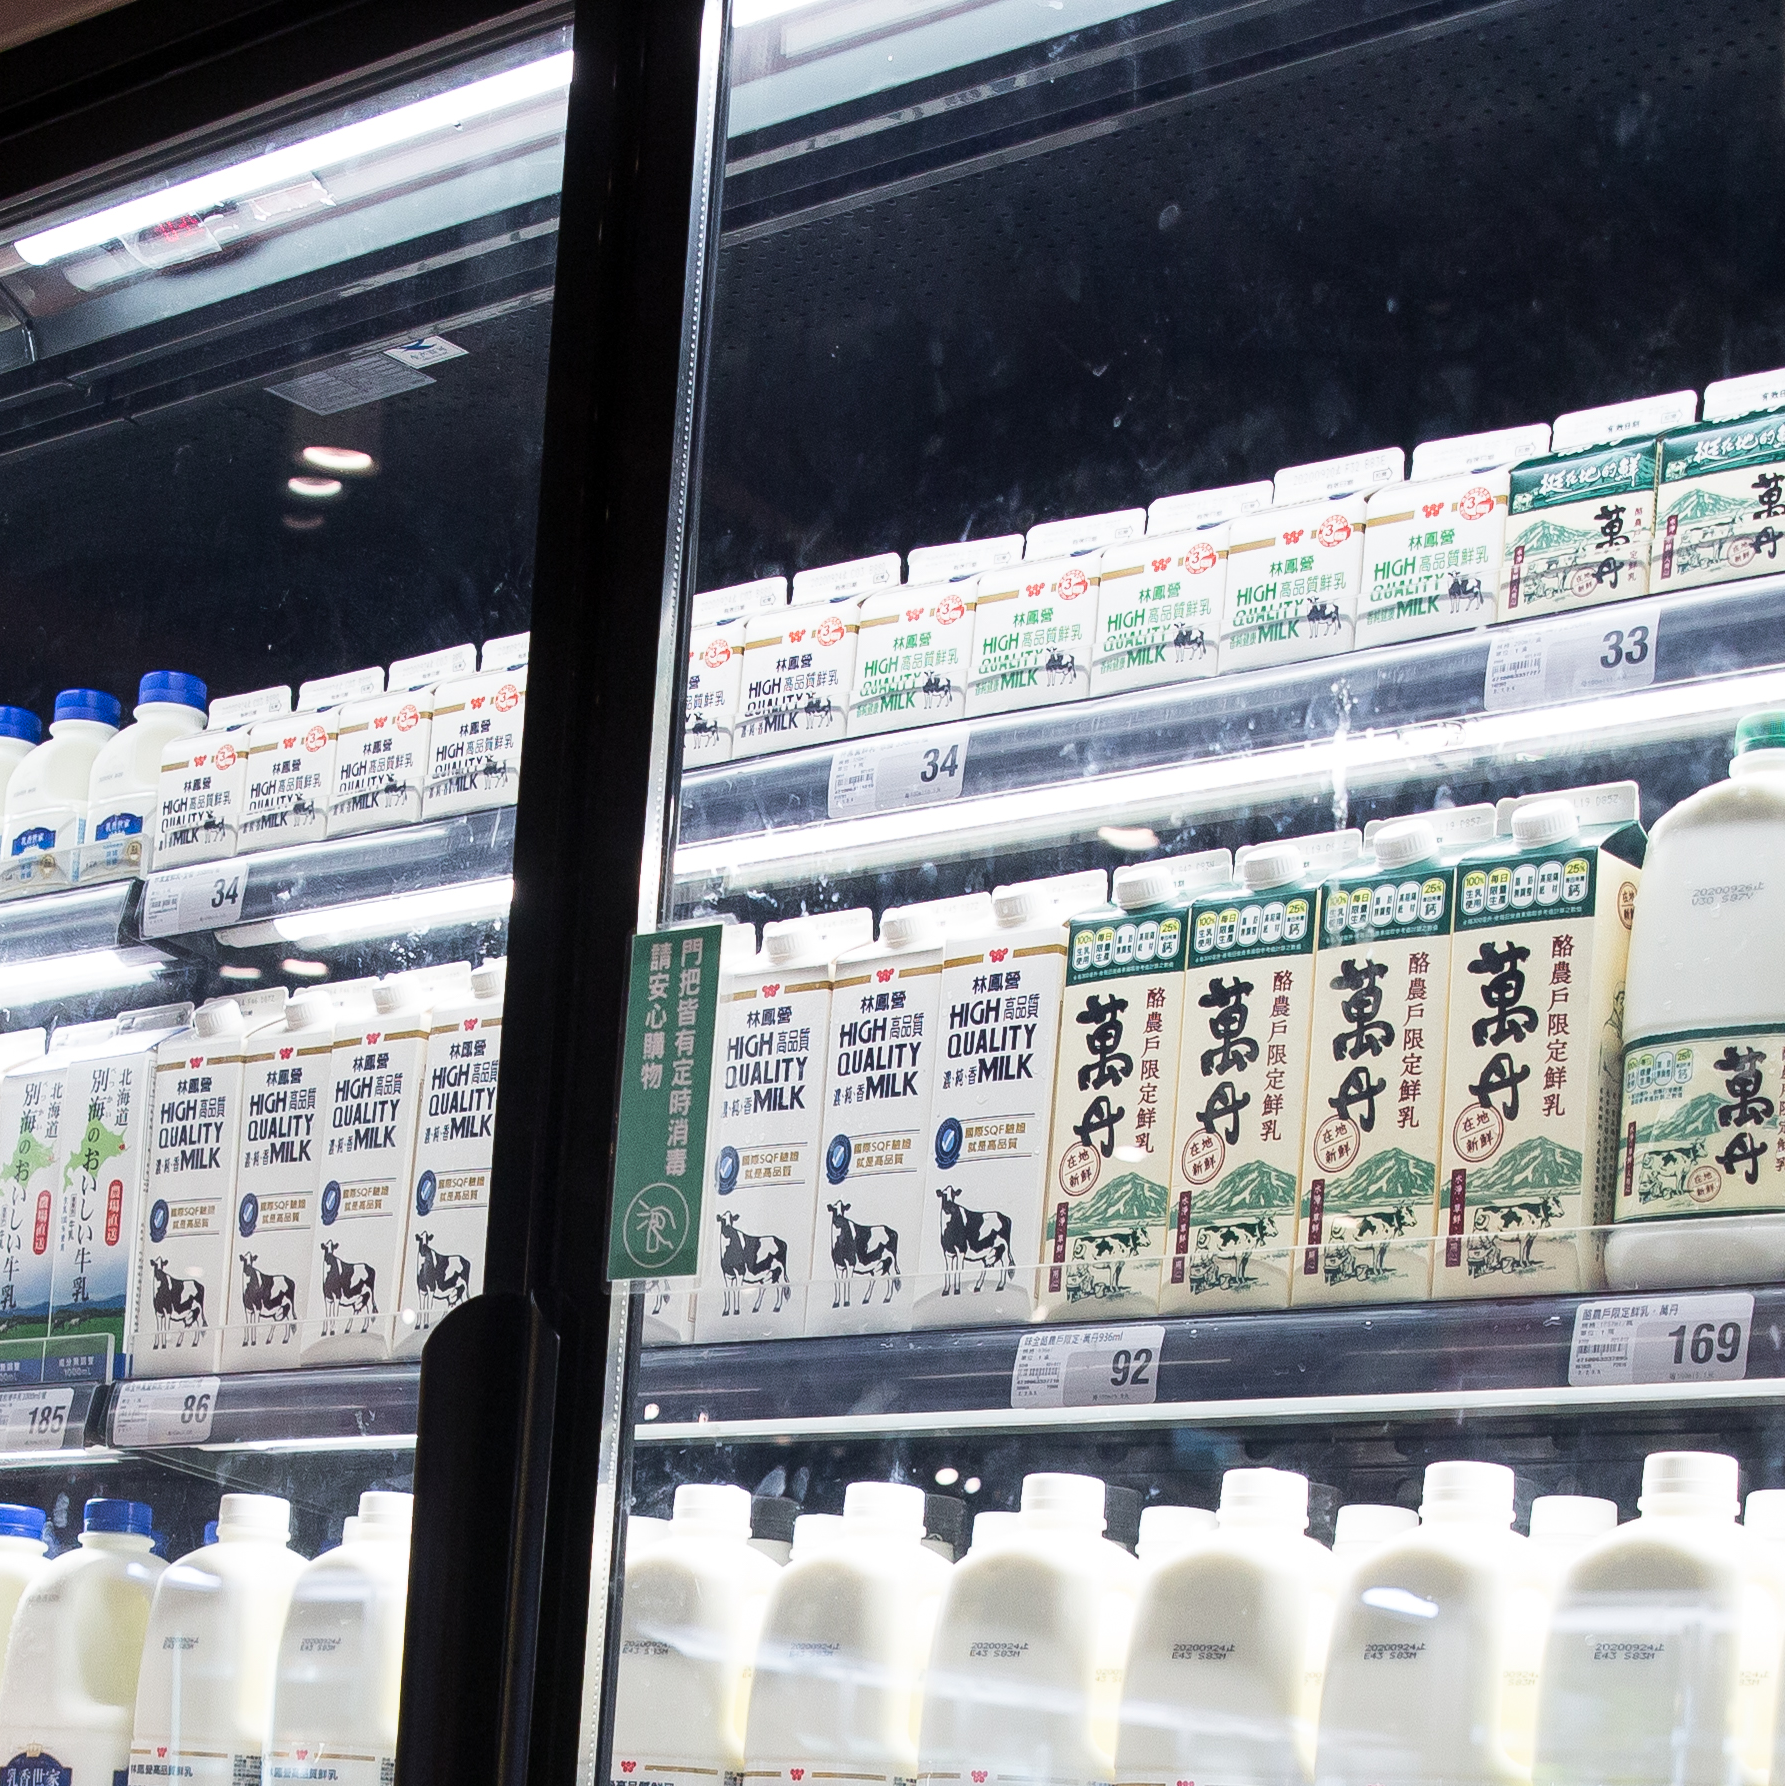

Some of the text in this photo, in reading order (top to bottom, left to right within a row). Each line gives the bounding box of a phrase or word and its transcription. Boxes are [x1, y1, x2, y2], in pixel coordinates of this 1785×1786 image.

[1408, 529, 1455, 551] 林鳳營
[1592, 505, 1630, 588] 萬丹
[1270, 555, 1314, 577] 林鳳營
[1374, 546, 1489, 581] HIGH 高品質鮮乳
[1237, 571, 1347, 606] HIGH 高品質鮮乳
[1397, 594, 1440, 620] MILK
[1258, 619, 1299, 644] MILK
[776, 654, 812, 671] 林鳳營
[1600, 626, 1649, 669] 33
[749, 670, 839, 698] HIGH 高品質鮮乳
[764, 714, 797, 733] MILK
[363, 739, 392, 757] 林鳳營
[341, 751, 413, 780] HIGH 高品質鮮乳
[920, 745, 959, 783] 34
[1466, 876, 1485, 887] 100%
[1567, 863, 1586, 874] 25%
[212, 879, 239, 907] 34
[973, 971, 1021, 993] 林鳳營
[641, 942, 673, 1090] 請安心購物
[861, 991, 906, 1012] 林鳳營
[950, 994, 1040, 1029] HIGH 高品質
[840, 1012, 923, 1046] HIGH 高品質
[947, 1023, 1036, 1058] QUALITY
[1397, 951, 1430, 1128] 酪農戶限定鮮乳
[1467, 941, 1539, 1122] 萬丹
[1543, 935, 1574, 1117] 酪農戶限定鮮乳
[665, 938, 704, 1178] 門把皆有定時消毒
[837, 1042, 921, 1076] QUALITY
[1196, 977, 1259, 1145] 萬丹
[1261, 970, 1294, 1143] 酪農戶限定鮮乳
[1329, 959, 1395, 1133] 萬丹
[353, 1054, 389, 1071] 林鳳營
[978, 1053, 1033, 1083] MILK
[1074, 993, 1134, 1159] 萬丹
[1134, 987, 1167, 1155] 酪農戶限定鮮乳
[117, 1068, 132, 1127] 北海道
[336, 1074, 402, 1099] HIGH 高品質
[866, 1071, 918, 1100] MILK
[332, 1101, 399, 1129] QUALITY
[1462, 1114, 1490, 1135] 在地
[1713, 1047, 1774, 1184] 萬丹
[354, 1125, 396, 1149] MILK
[967, 1137, 1018, 1153] 就是高品質
[1466, 1131, 1496, 1153] 新鮮
[71, 1068, 111, 1303] 別海のおいしい牛乳
[1668, 1322, 1740, 1366] 169
[1111, 1349, 1152, 1386] 92
[28, 1406, 64, 1433] 185
[182, 1395, 210, 1423] 86
